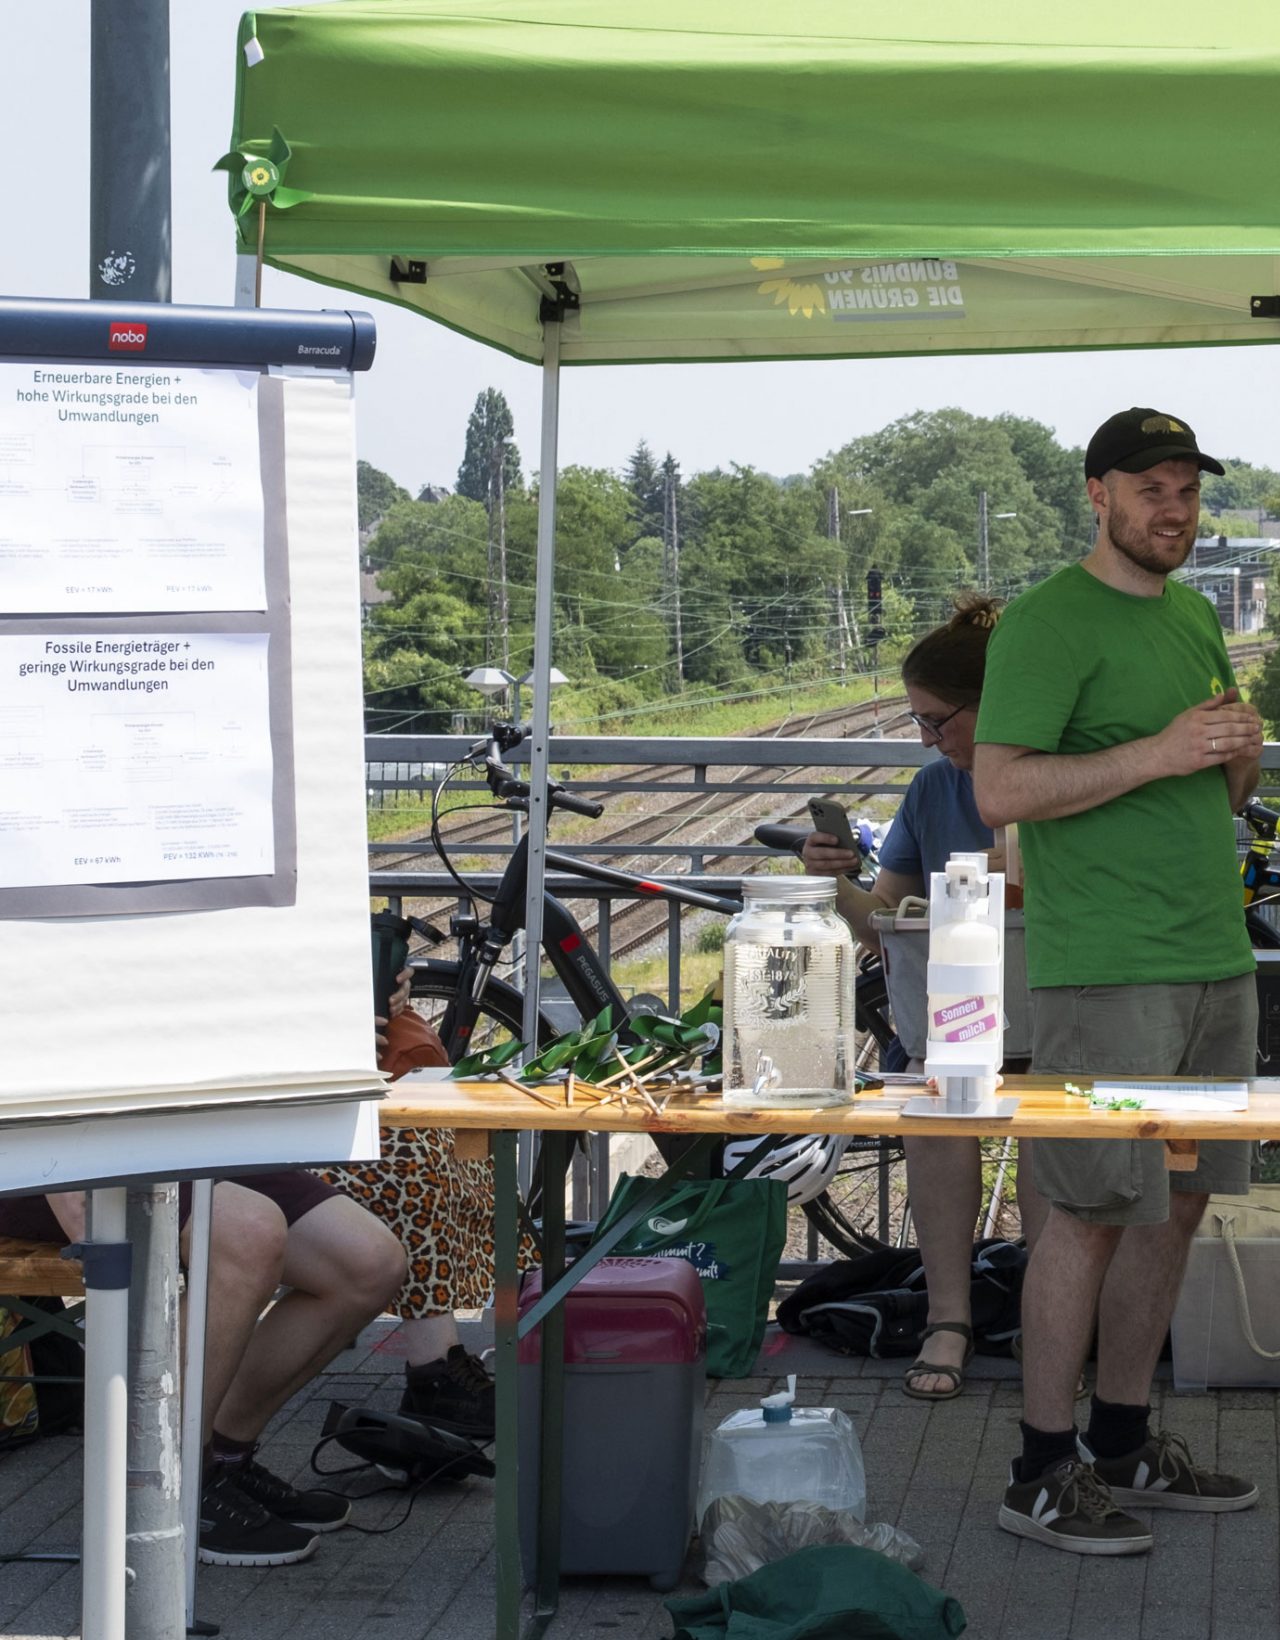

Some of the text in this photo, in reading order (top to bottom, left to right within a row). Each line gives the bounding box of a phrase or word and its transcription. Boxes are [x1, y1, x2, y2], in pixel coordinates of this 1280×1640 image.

[112, 331, 145, 344] nobo
[298, 344, 341, 355] Barracuda
[33, 370, 182, 388] Erneuerbare Energien +
[17, 389, 198, 408] hohe Wirkungsgrade bei den
[58, 409, 159, 426] Umwandlungen
[45, 640, 191, 657] Fossile Energieträger +
[19, 658, 215, 677] geringe Wirkungsgrade bei den
[67, 678, 168, 694] Umwandlungen
[577, 955, 609, 1002] PEGASUS
[941, 1001, 978, 1022] Sonnen
[958, 1020, 986, 1042] milch
